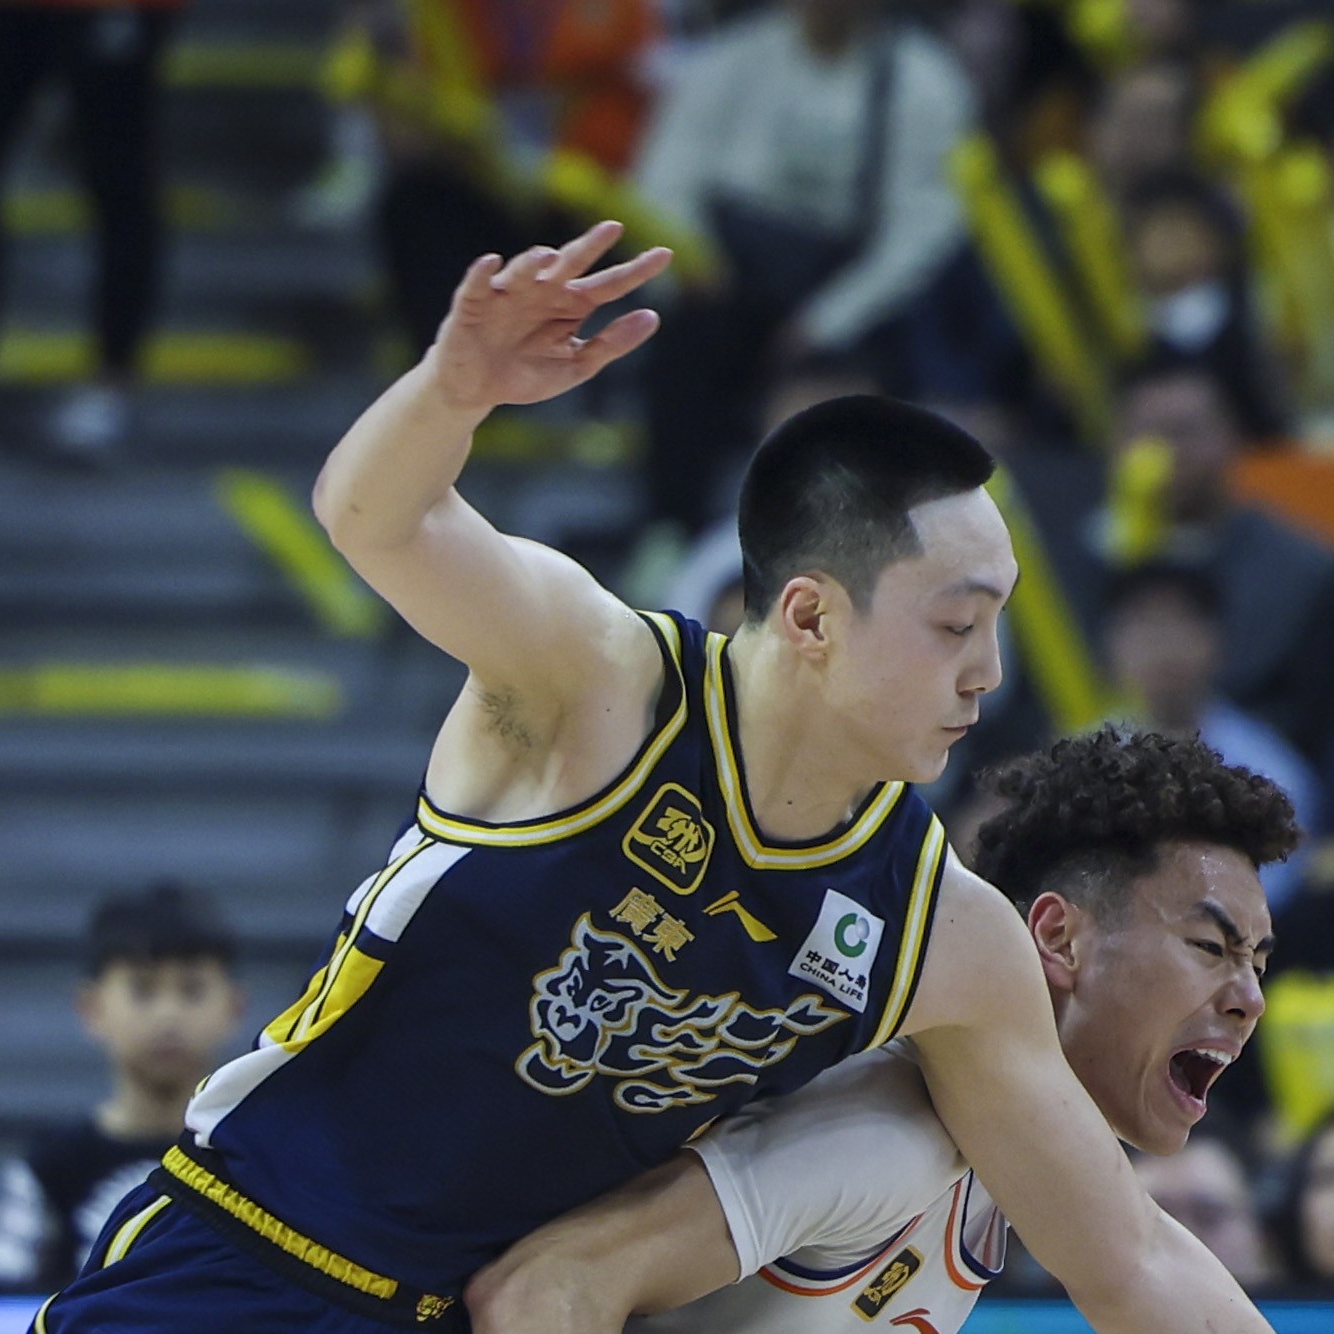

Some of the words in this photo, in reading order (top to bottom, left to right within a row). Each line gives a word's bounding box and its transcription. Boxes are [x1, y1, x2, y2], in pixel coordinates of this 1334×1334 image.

[608, 886, 695, 963] 廣東
[799, 962, 836, 987] CHINA
[839, 984, 864, 1001] LIFE
